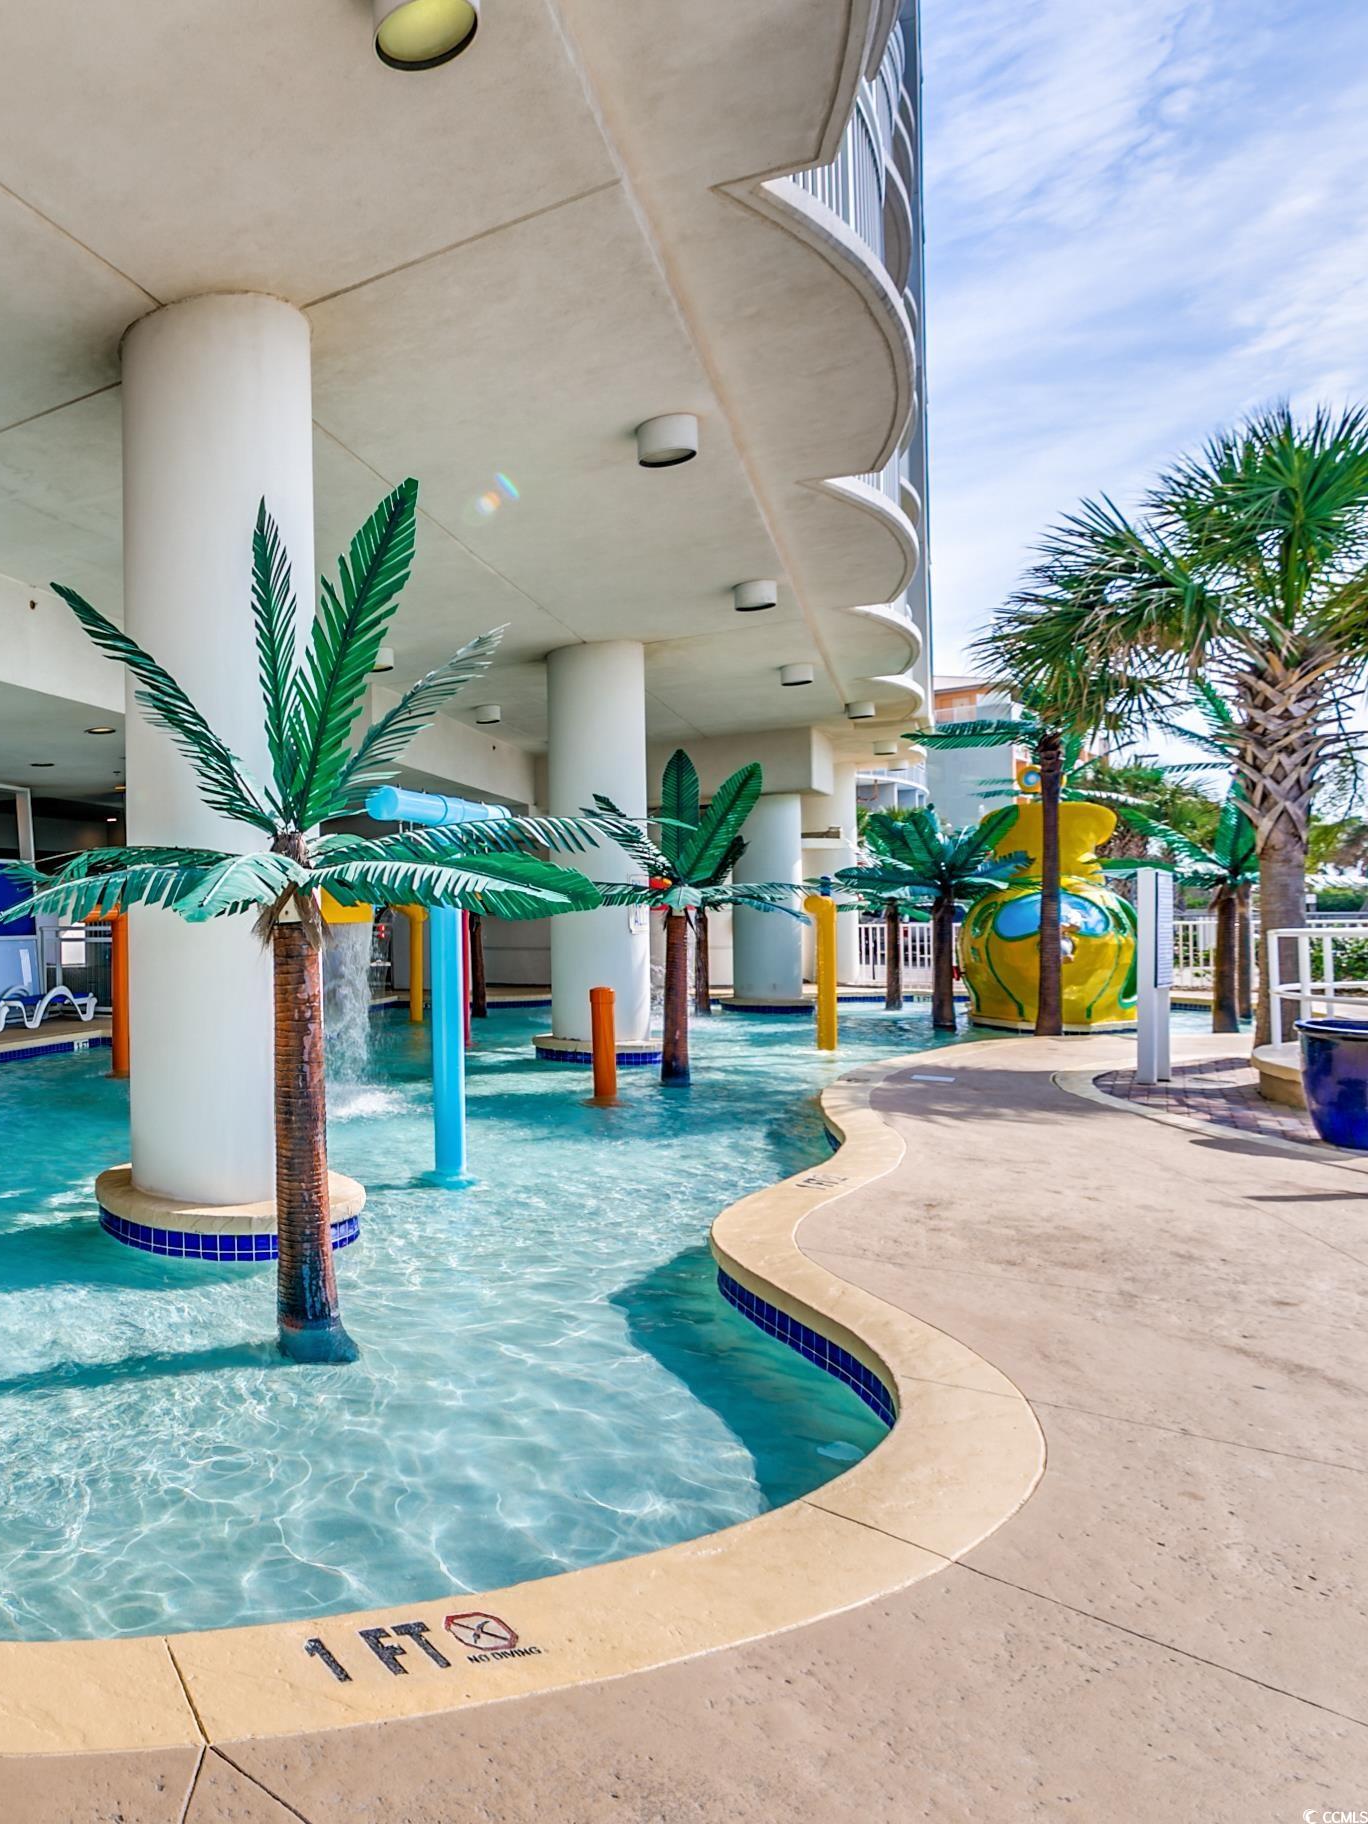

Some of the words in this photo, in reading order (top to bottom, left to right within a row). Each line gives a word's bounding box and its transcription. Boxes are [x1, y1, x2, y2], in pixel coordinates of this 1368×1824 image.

[304, 1637, 353, 1682] 1
[358, 1621, 452, 1676] FT
[467, 1654, 490, 1664] NO
[490, 1646, 542, 1661] DIVING
